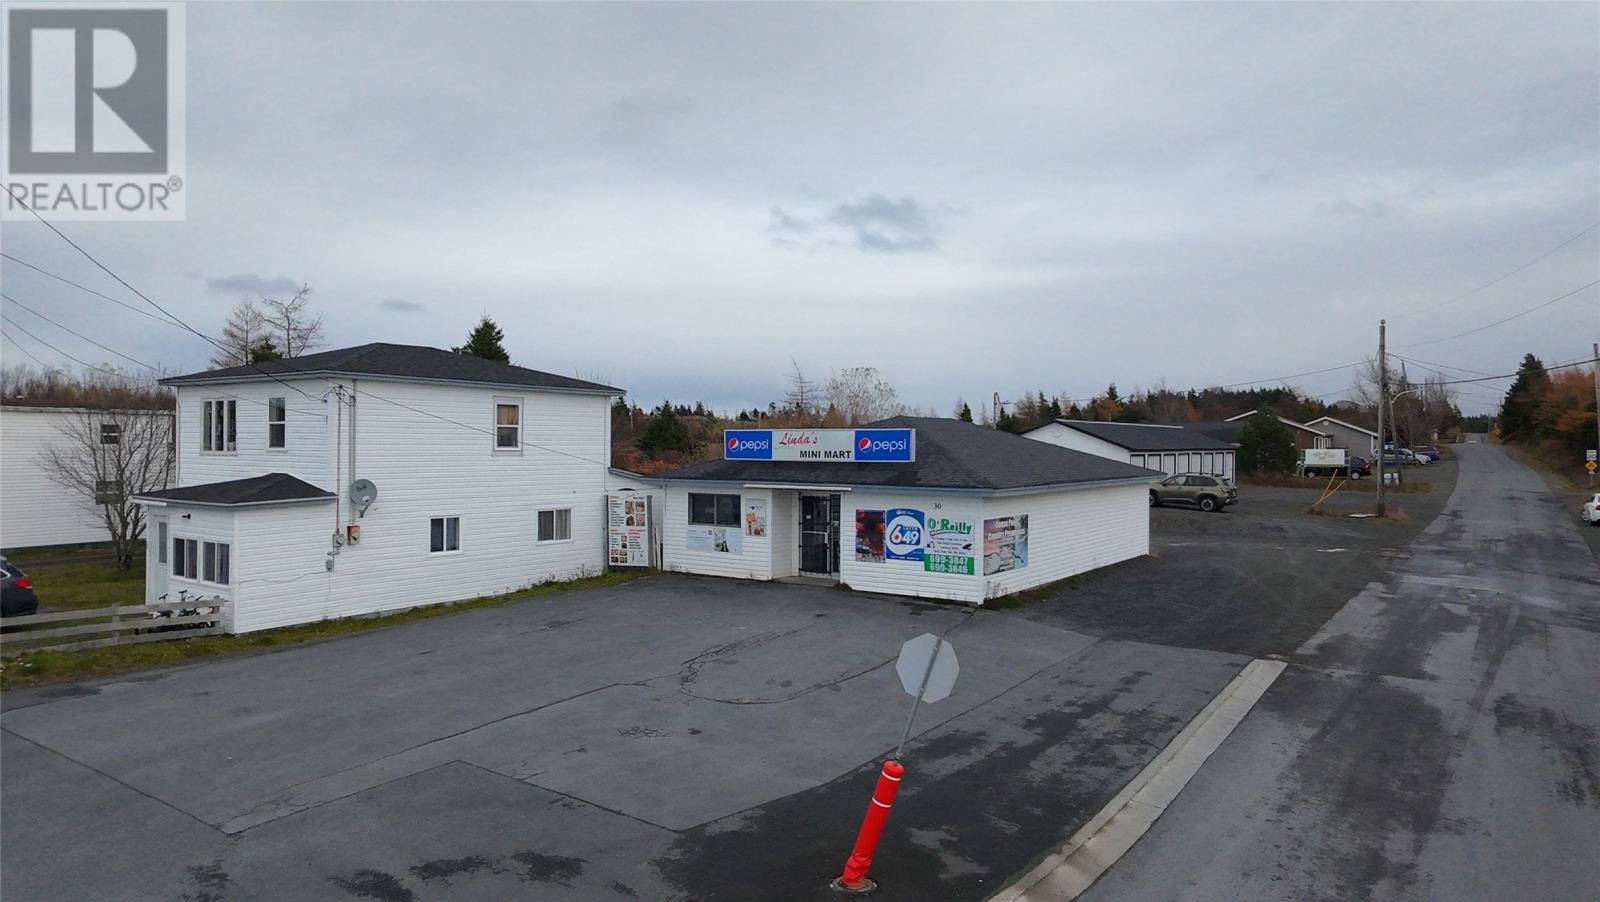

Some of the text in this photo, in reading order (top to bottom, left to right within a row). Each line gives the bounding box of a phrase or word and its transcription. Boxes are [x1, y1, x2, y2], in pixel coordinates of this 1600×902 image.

[740, 439, 769, 451] pepsi
[778, 431, 818, 446] Linda's
[872, 438, 907, 452] pepsi
[799, 450, 852, 459] MINI MART
